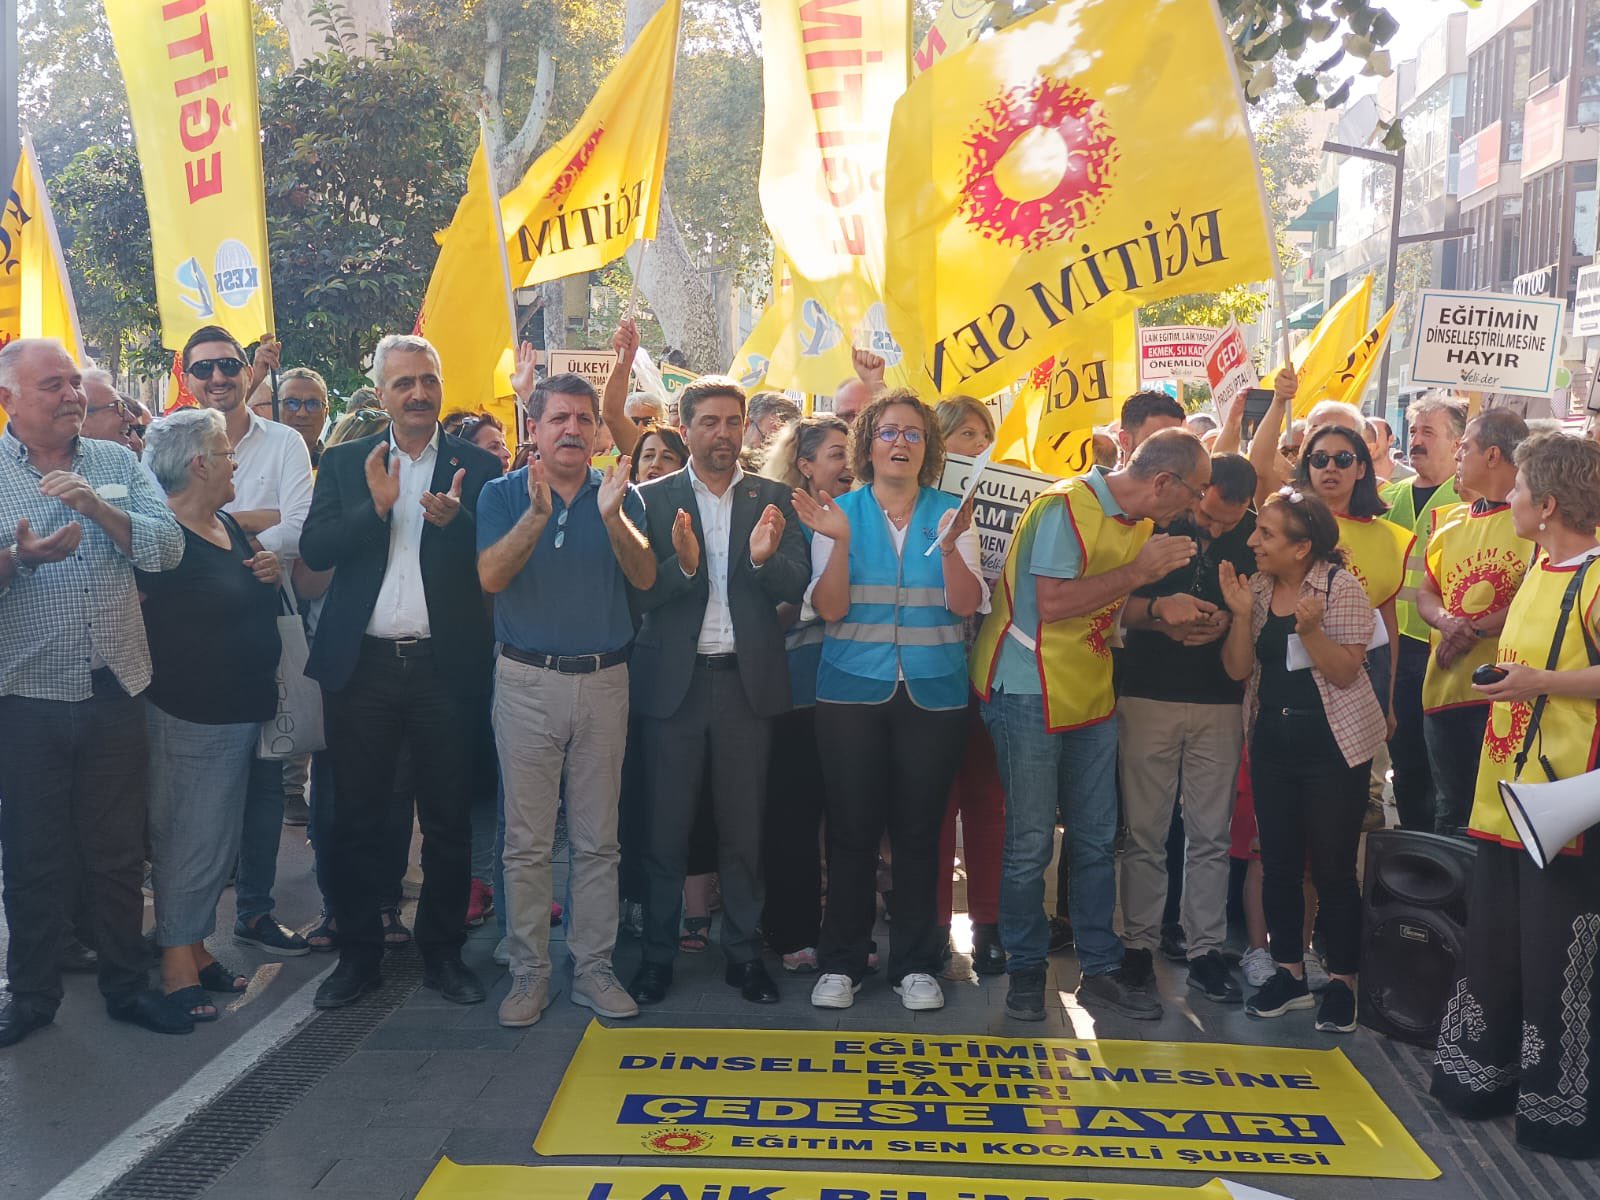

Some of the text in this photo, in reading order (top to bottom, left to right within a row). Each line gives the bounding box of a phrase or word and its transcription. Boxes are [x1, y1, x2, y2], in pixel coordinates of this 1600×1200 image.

[1439, 304, 1539, 331] EĞİTİMİN
[1177, 345, 1187, 355] SU
[1188, 344, 1205, 356] KAD
[1426, 325, 1547, 352] DİNSELLEŞTİRİLMESİNE
[568, 359, 610, 374] ÜLKEYİ
[1446, 349, 1520, 368] HAYIR
[834, 1038, 1092, 1061] EĞİTİMİN
[619, 1052, 1321, 1090] DİNSELLEŞTİRİLMESİNE
[868, 1079, 1072, 1100] HAYIR!
[642, 1097, 1318, 1138] ÇEDES'E HAYIR!
[731, 1133, 873, 1151] EĞİTİM
[887, 1140, 967, 1154] SEN
[983, 1142, 1163, 1160] KOCAELİ
[1177, 1149, 1331, 1166] ŞUBESİ
